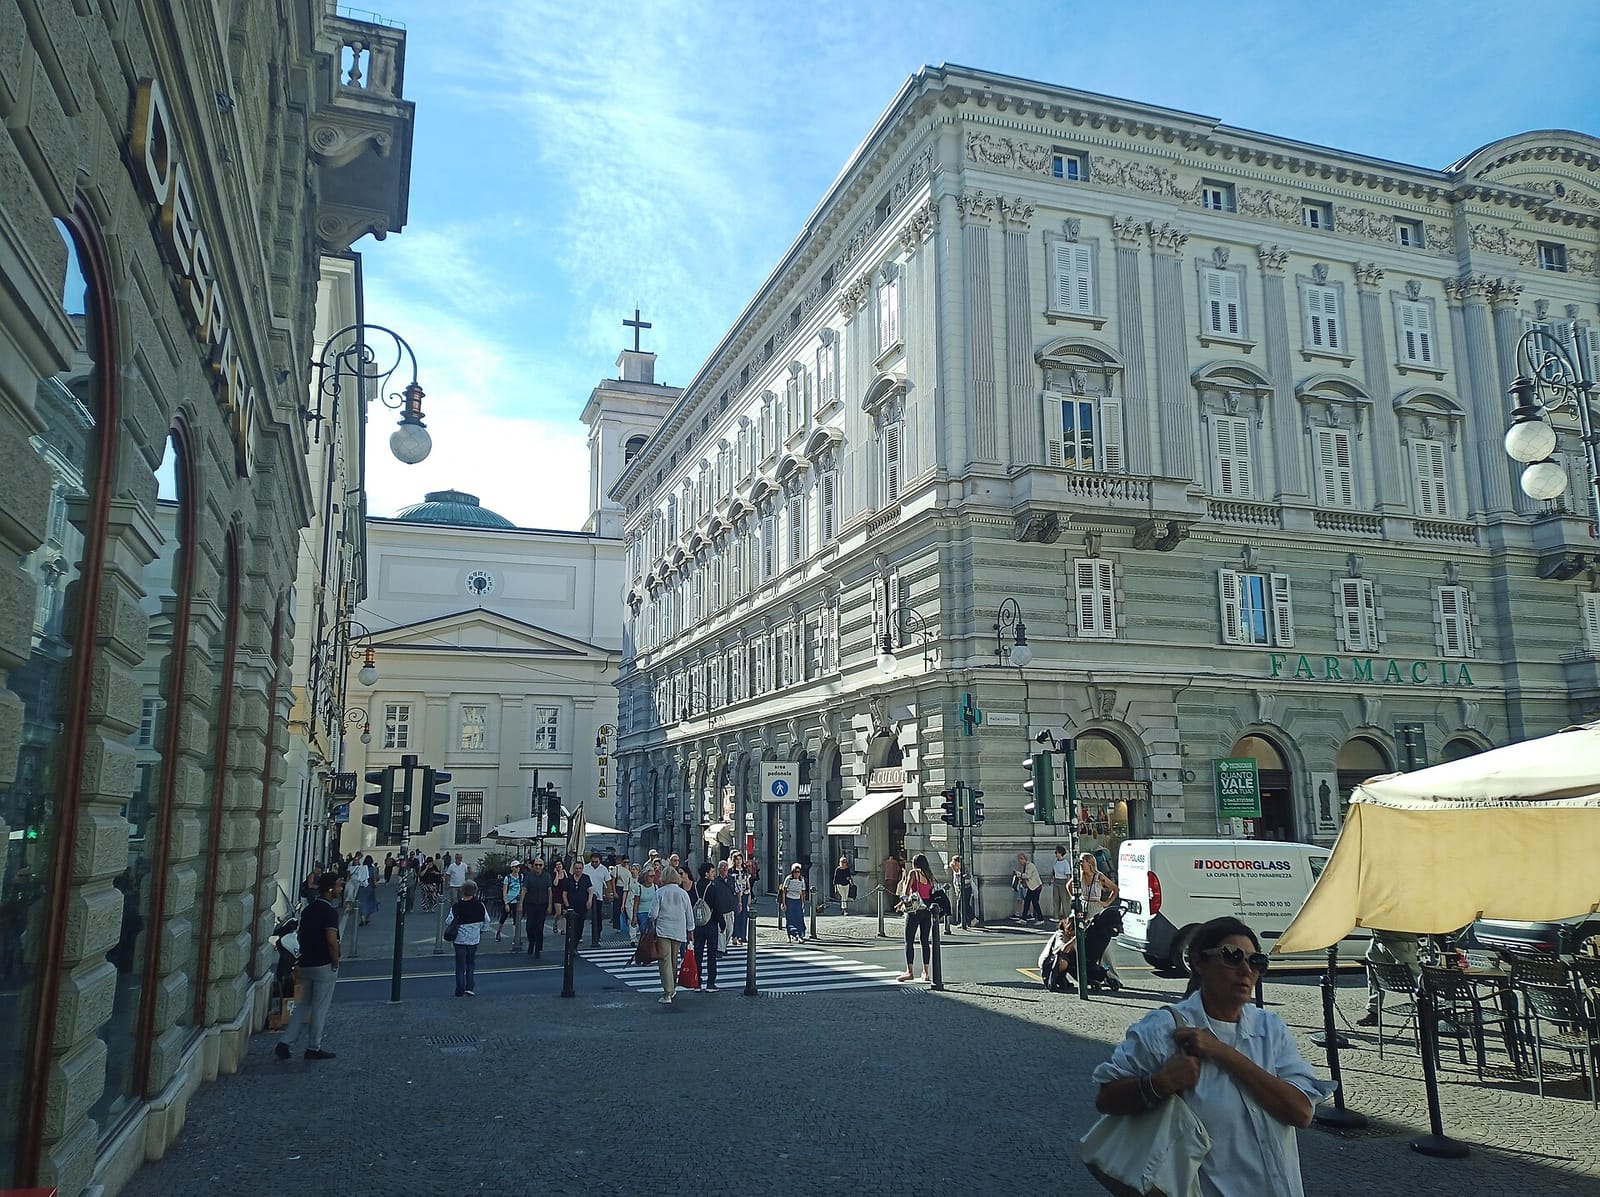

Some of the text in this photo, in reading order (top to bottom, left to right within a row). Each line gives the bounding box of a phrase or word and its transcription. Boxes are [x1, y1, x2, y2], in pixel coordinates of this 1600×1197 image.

[1268, 653, 1475, 686] FARMACIA
[1220, 771, 1253, 780] QUANTO
[1220, 779, 1254, 789] VALE
[1205, 859, 1291, 871] DOCTORGLASS
